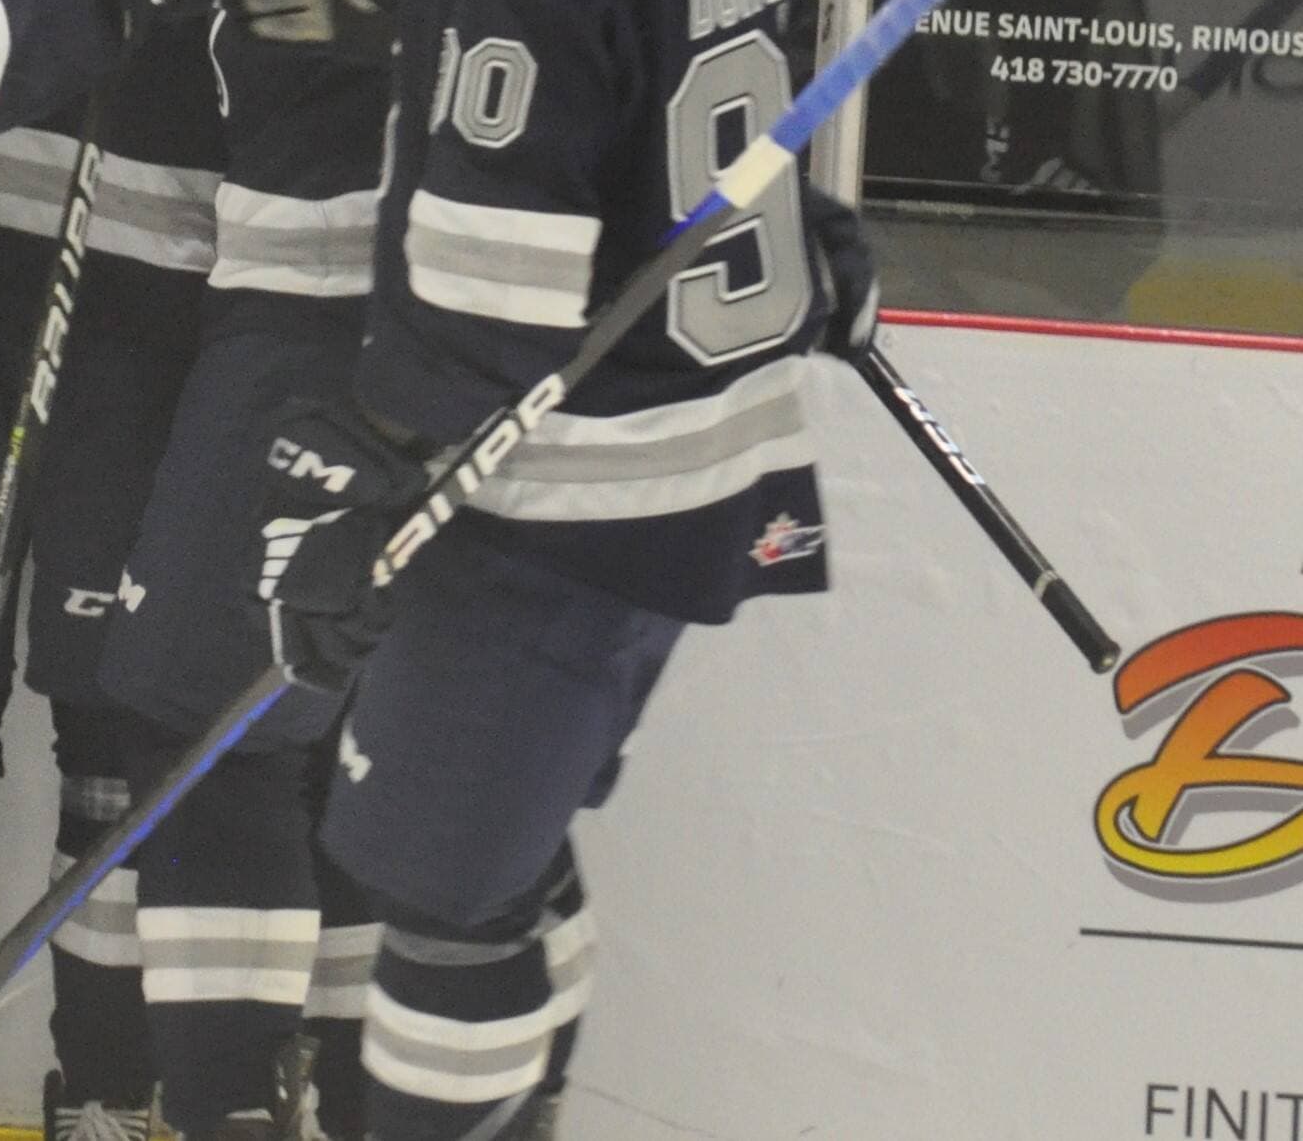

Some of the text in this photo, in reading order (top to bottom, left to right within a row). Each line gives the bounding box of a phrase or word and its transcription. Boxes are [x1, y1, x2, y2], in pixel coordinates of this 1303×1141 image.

[998, 12, 1182, 54] SAINT-LOUIS,
[1192, 24, 1303, 57] RIMOUS
[990, 55, 1178, 92] 418 730-7770
[1144, 1083, 1303, 1141] FINIT
